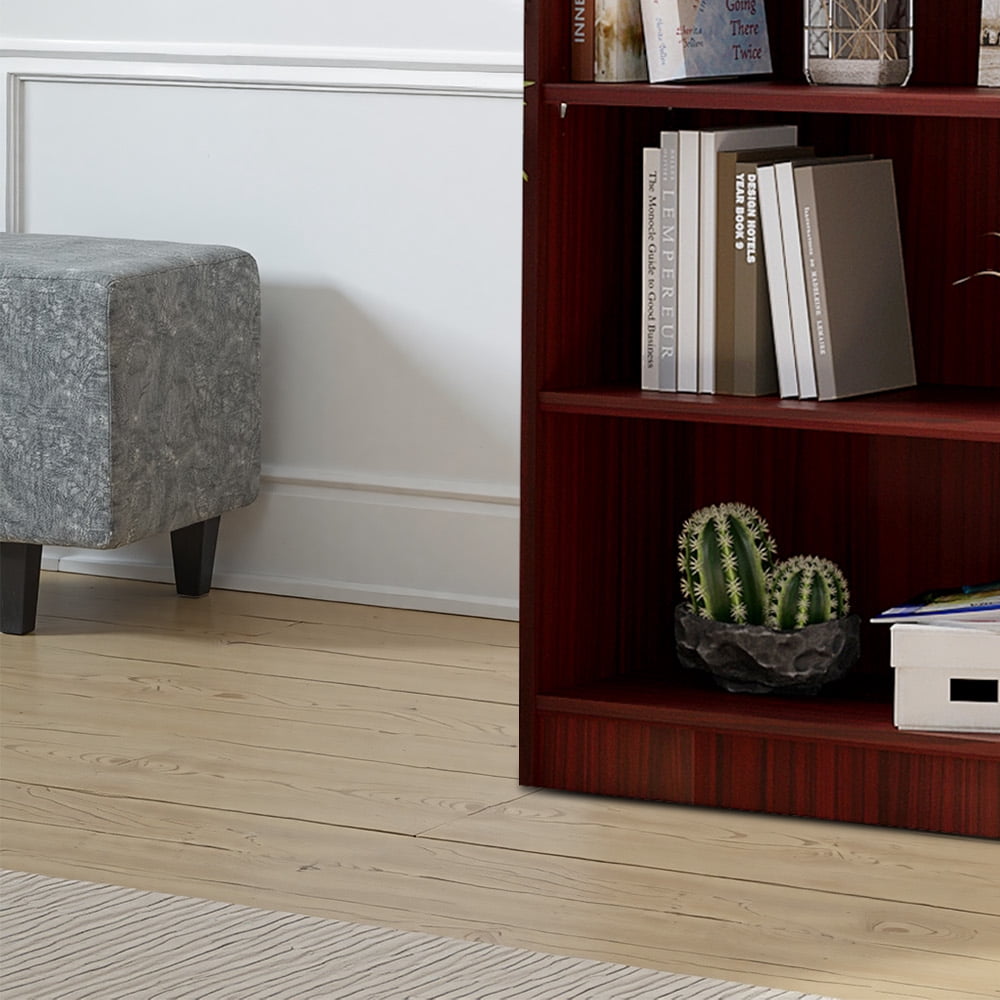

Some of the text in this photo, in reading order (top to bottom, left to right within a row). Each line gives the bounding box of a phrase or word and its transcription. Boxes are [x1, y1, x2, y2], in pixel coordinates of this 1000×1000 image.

[730, 20, 758, 36] There
[732, 44, 762, 60] Twice
[735, 173, 744, 250] YEAR BOOK 9
[747, 174, 757, 264] DESIGN HOTELS
[647, 171, 657, 368] The Monocle Guide to Good Business
[661, 190, 675, 358] LEMPEREUR
